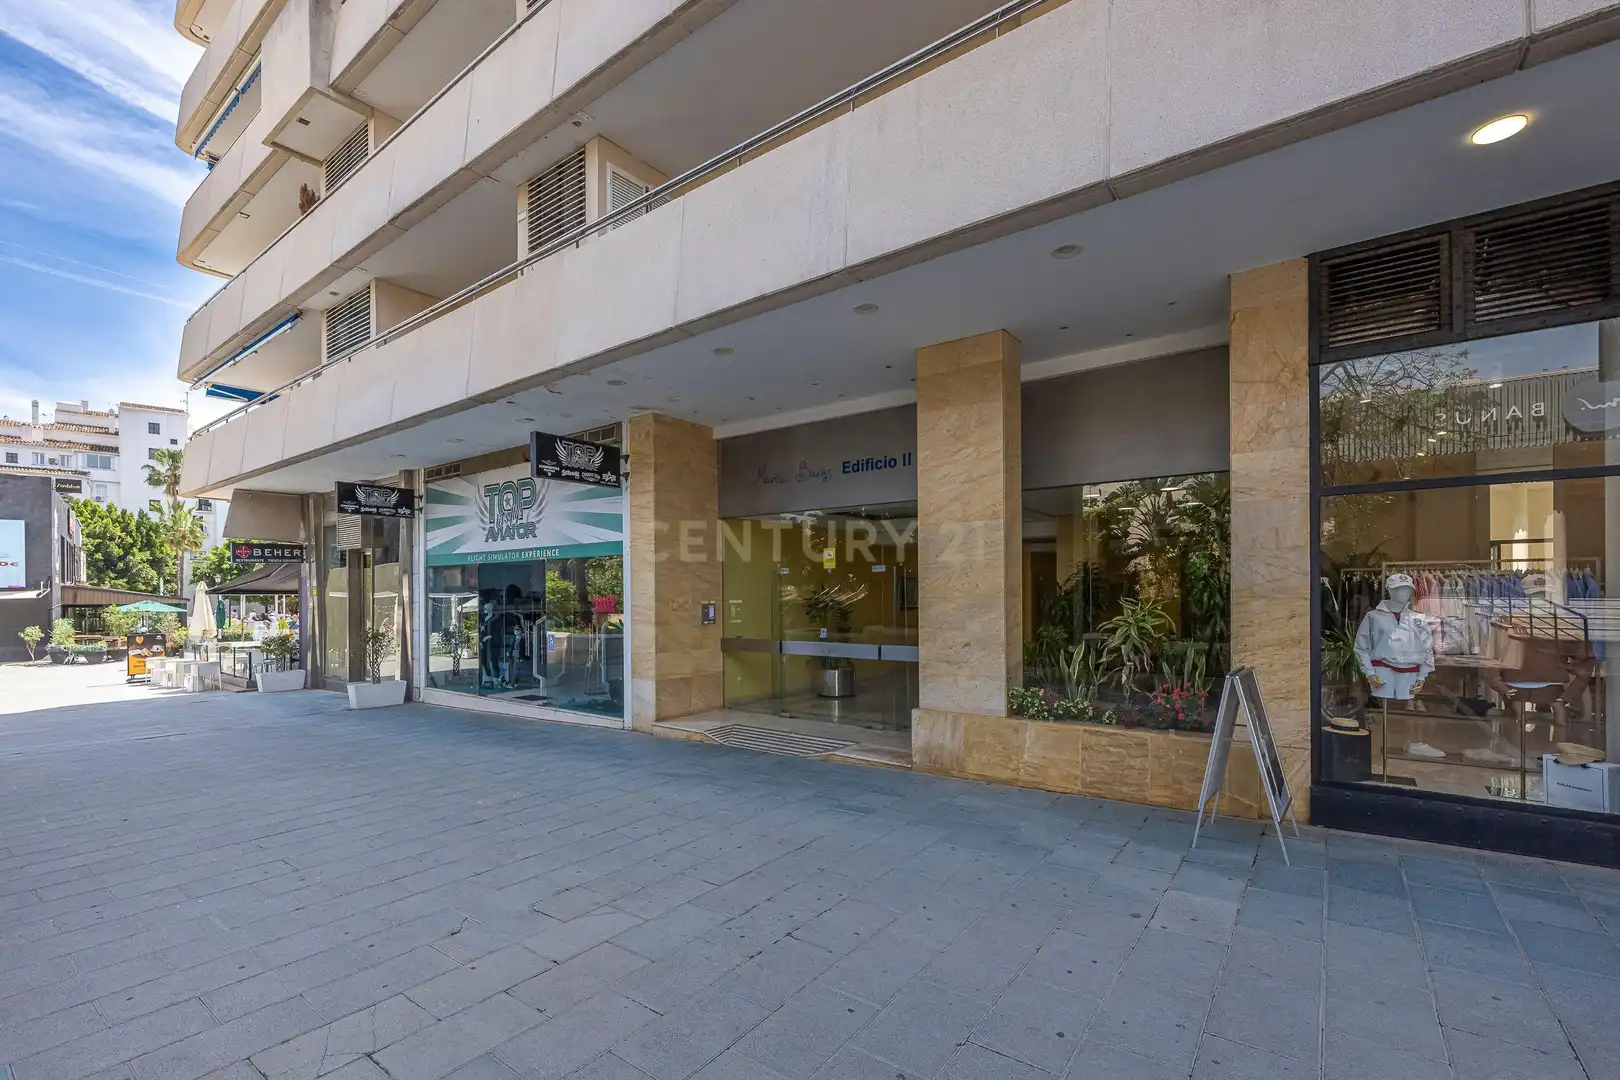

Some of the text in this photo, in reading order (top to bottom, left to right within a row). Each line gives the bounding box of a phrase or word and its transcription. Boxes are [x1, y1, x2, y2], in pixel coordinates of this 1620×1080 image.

[842, 452, 912, 474] Edificio II
[484, 477, 537, 524] TOP
[485, 521, 537, 542] AVIATOR
[253, 548, 301, 557] BEHER
[467, 548, 560, 562] FLIGHT SIMULATOR EXPERIENCE
